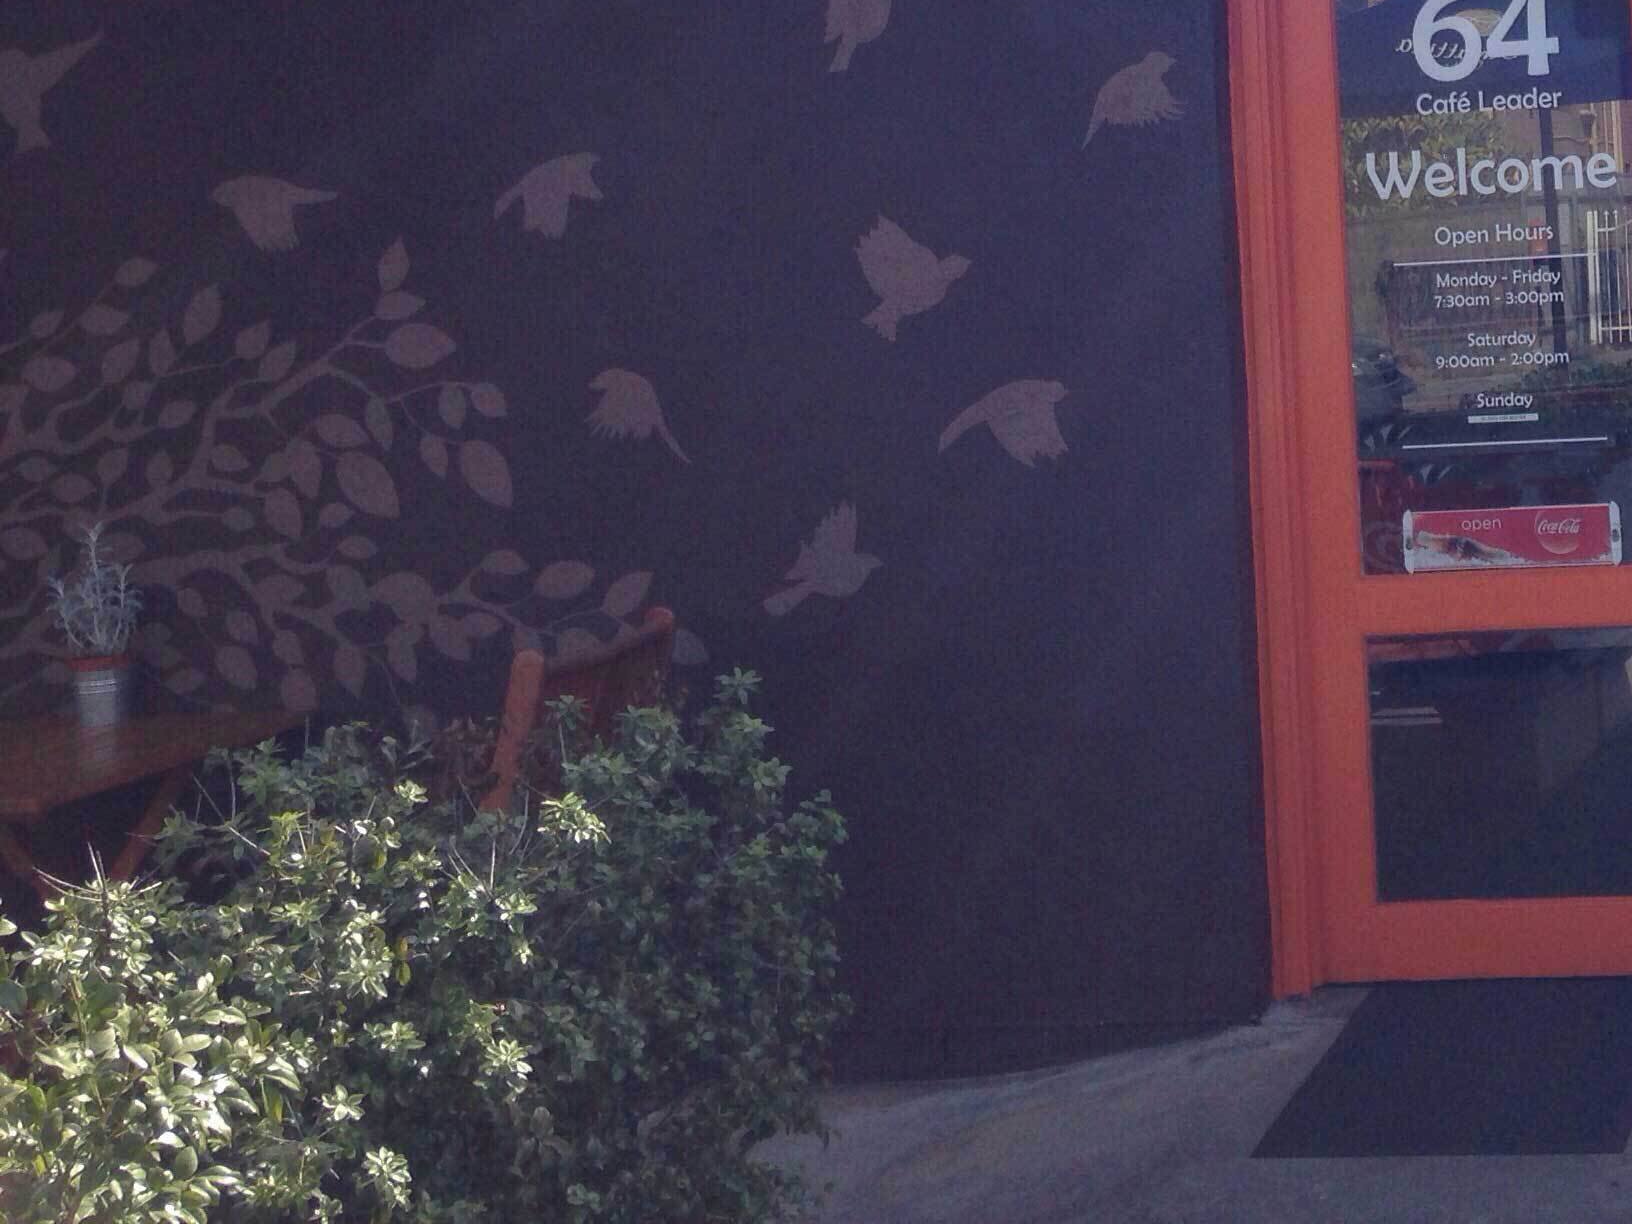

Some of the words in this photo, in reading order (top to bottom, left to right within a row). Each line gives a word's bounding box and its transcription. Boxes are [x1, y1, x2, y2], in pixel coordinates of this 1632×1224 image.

[1416, 91, 1471, 116] Café
[1478, 87, 1562, 113] Leader
[1366, 147, 1617, 200] Welcome
[1434, 226, 1489, 247] Open
[1495, 223, 1554, 243] Hours
[1436, 272, 1497, 288] Monday
[1512, 268, 1561, 284] Friday
[1434, 295, 1490, 308] 7:30am
[1505, 291, 1565, 306] 3:00pm
[1467, 330, 1536, 347] Saturday
[1435, 354, 1495, 369] 9:00am
[1511, 351, 1570, 366] 2:00pm
[1476, 392, 1534, 408] Sunday
[1461, 517, 1502, 533] open
